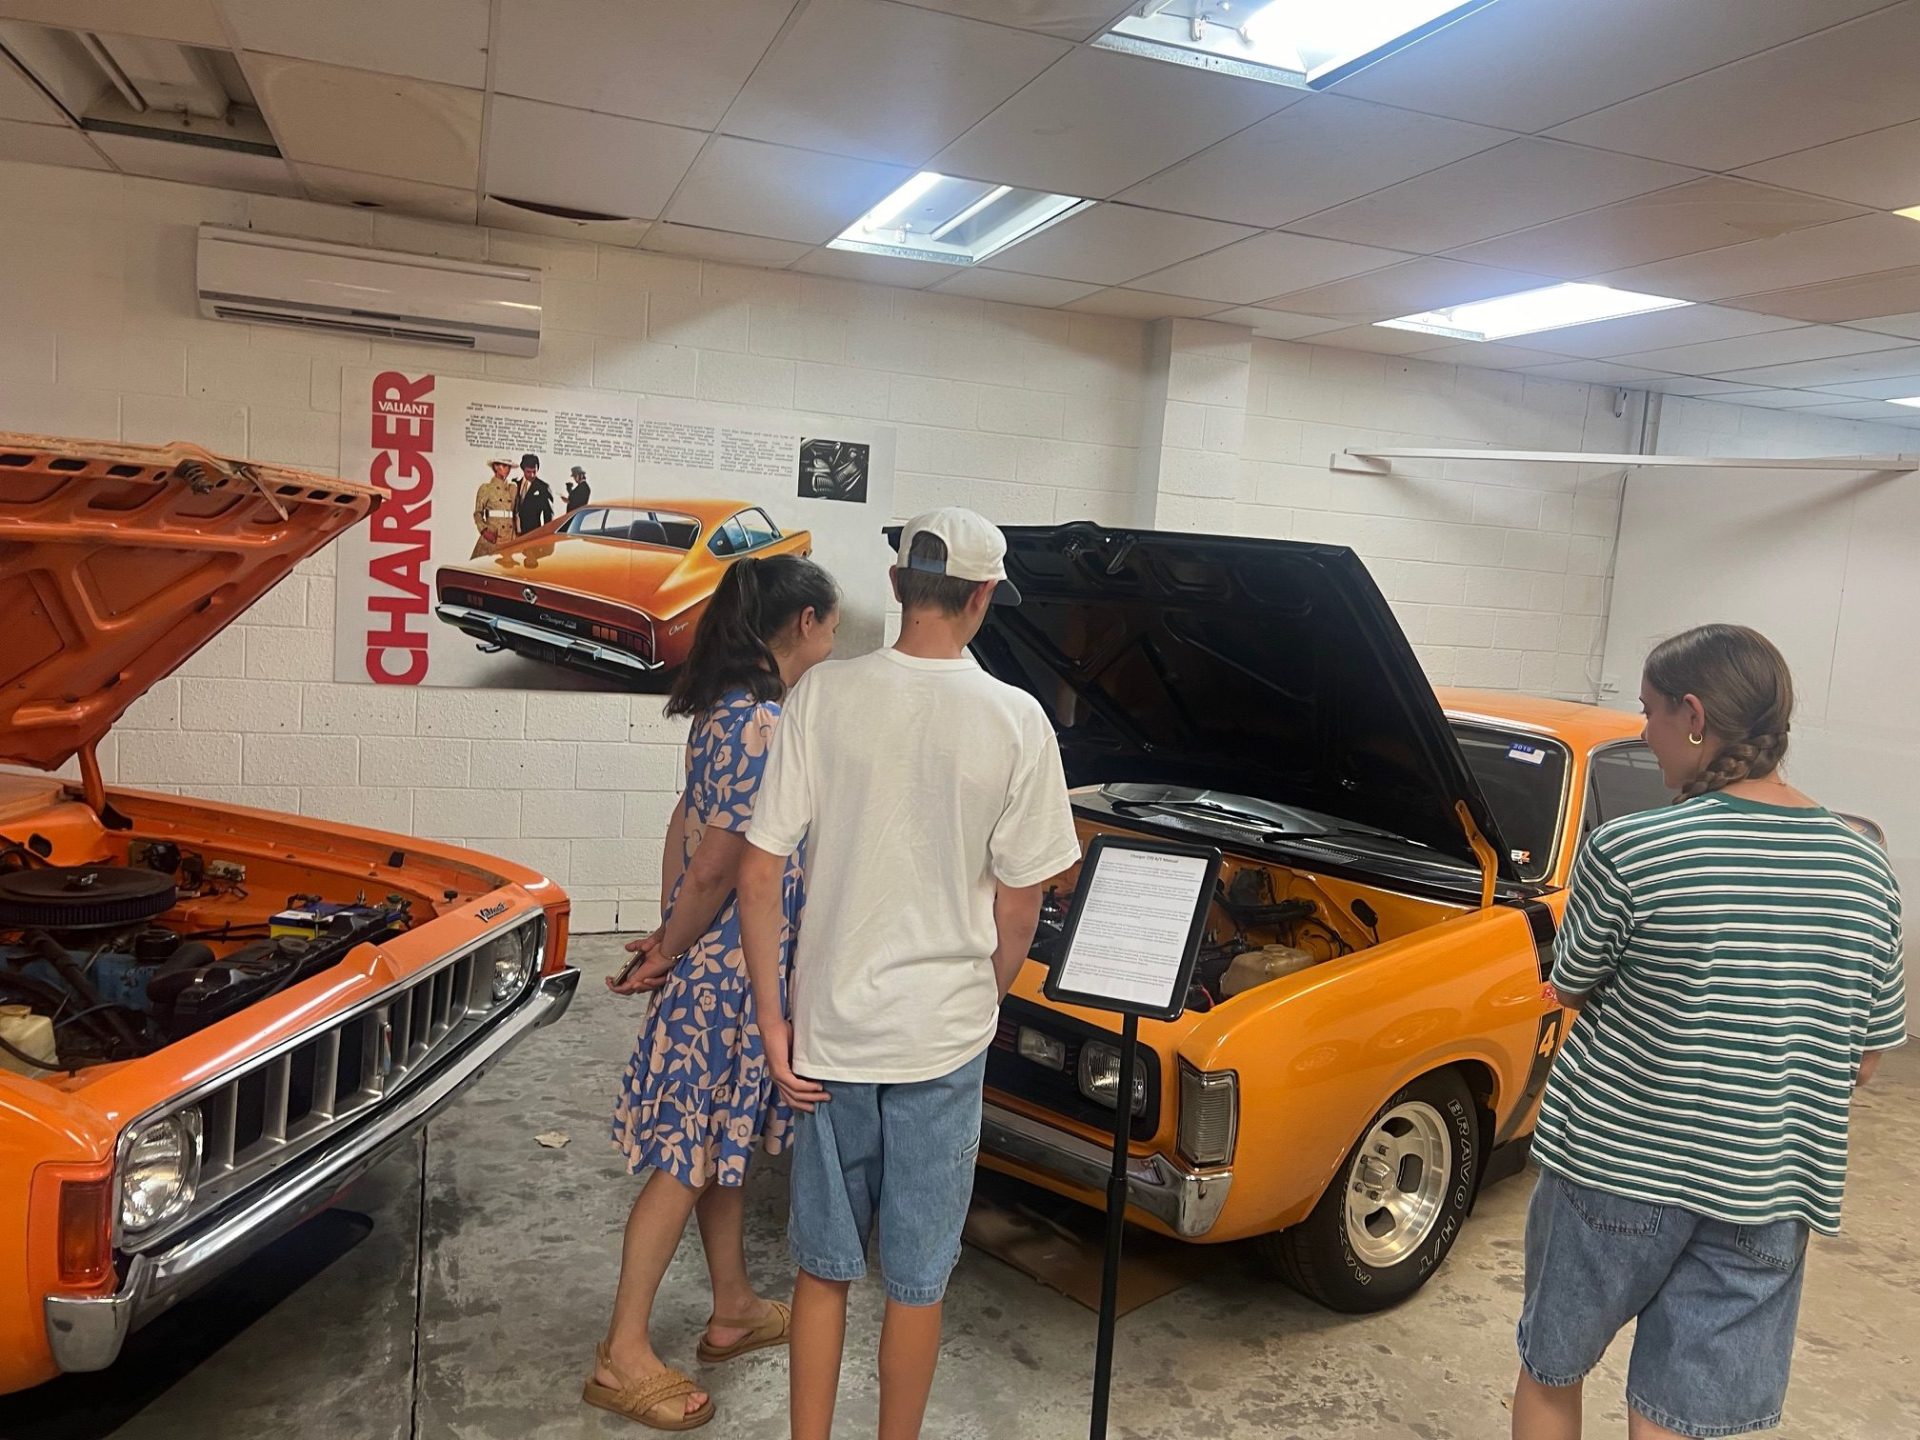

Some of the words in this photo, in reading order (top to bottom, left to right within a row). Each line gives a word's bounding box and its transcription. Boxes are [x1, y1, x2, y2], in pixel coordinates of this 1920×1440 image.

[378, 400, 429, 416] VALIANT
[365, 371, 435, 686] CHARGER
[1538, 1021, 1557, 1058] 4
[1447, 1099, 1476, 1210] BRAVO
